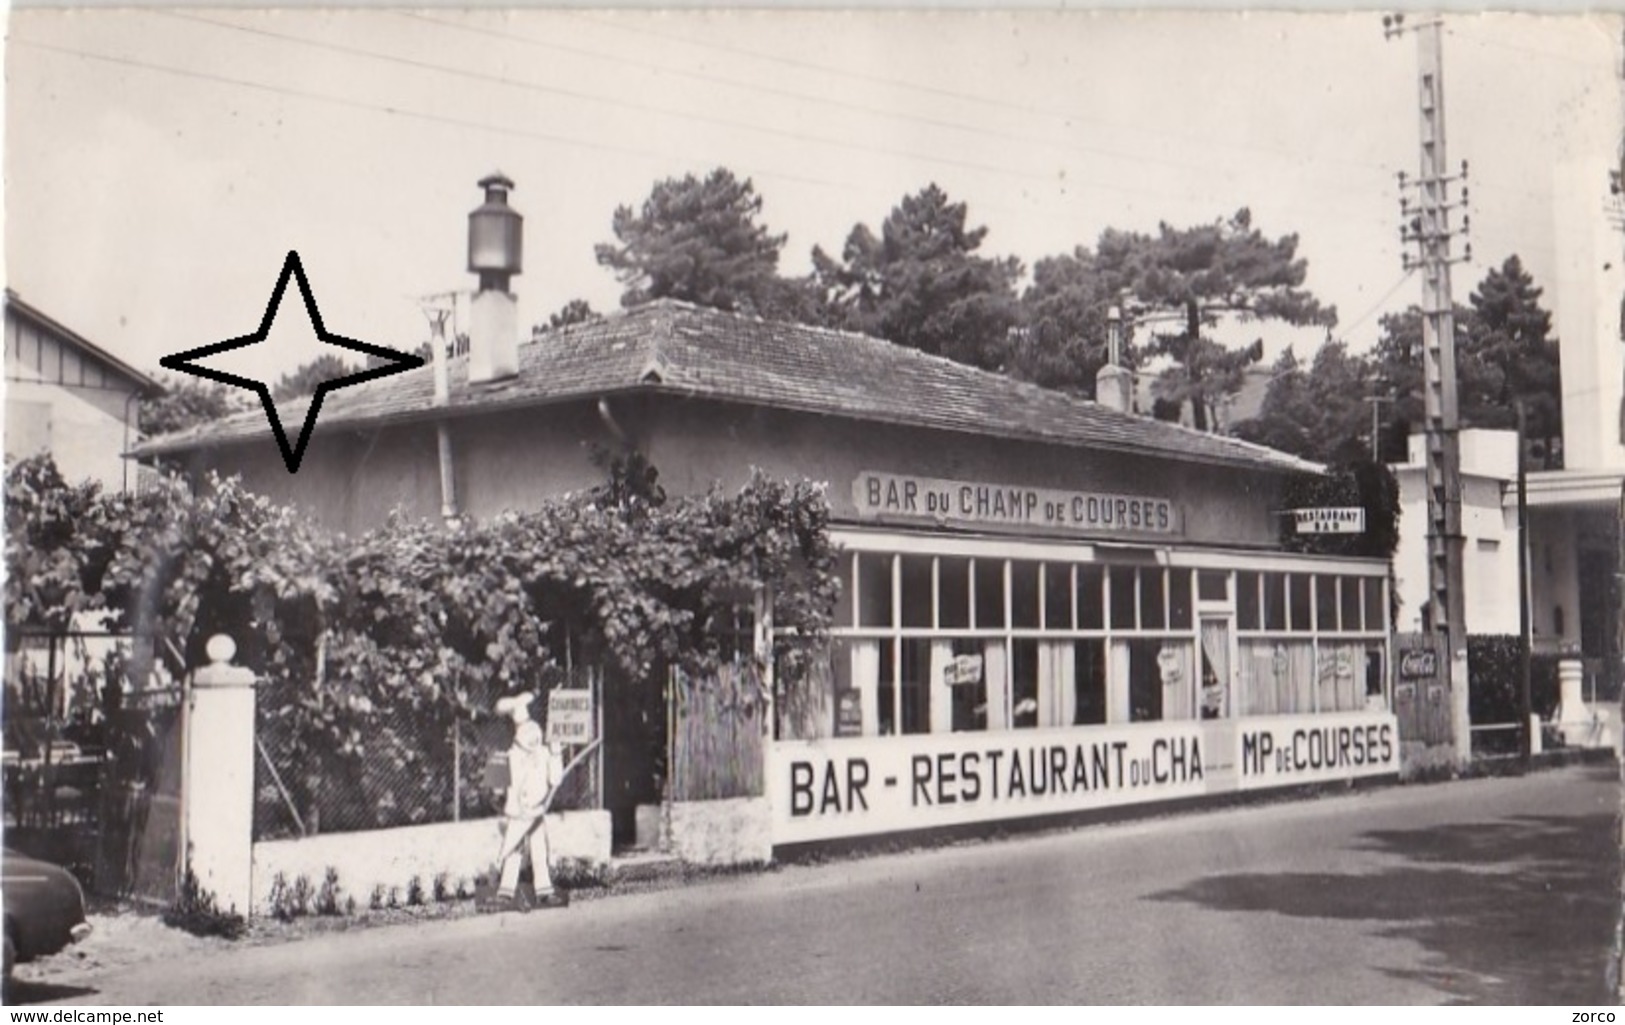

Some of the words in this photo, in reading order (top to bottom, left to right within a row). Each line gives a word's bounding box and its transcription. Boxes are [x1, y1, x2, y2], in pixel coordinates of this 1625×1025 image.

[867, 476, 918, 511] BAR
[927, 491, 950, 513] DU
[959, 486, 1037, 520] CHAMP
[1045, 502, 1065, 521] DE
[1073, 496, 1169, 528] COURSES
[790, 758, 869, 816] BAR
[912, 742, 1127, 807] RESTAURANT
[1129, 758, 1150, 787] DU
[1276, 746, 1292, 772] DE
[1292, 724, 1392, 771] COURSES
